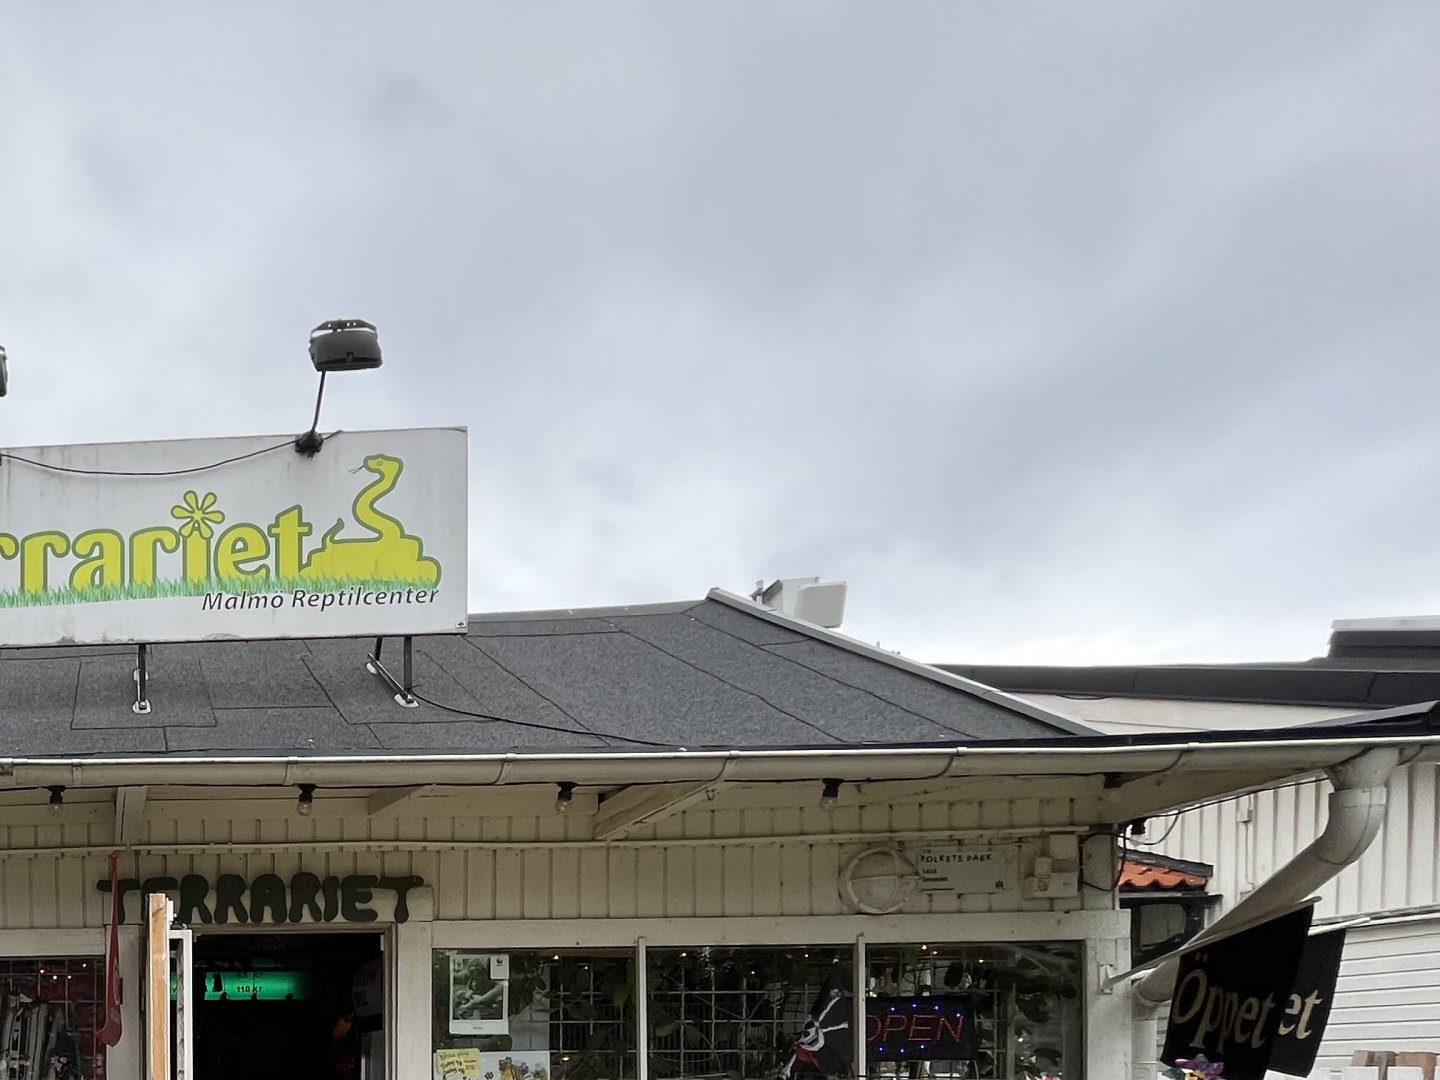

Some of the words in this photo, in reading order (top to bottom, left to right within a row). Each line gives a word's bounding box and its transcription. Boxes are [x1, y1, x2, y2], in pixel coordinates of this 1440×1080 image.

[202, 591, 284, 611] Malmö
[292, 587, 440, 612] Reptilcenter
[236, 985, 250, 993] 110
[1171, 952, 1276, 1054] Öppet
[865, 1014, 965, 1042] OPEN
